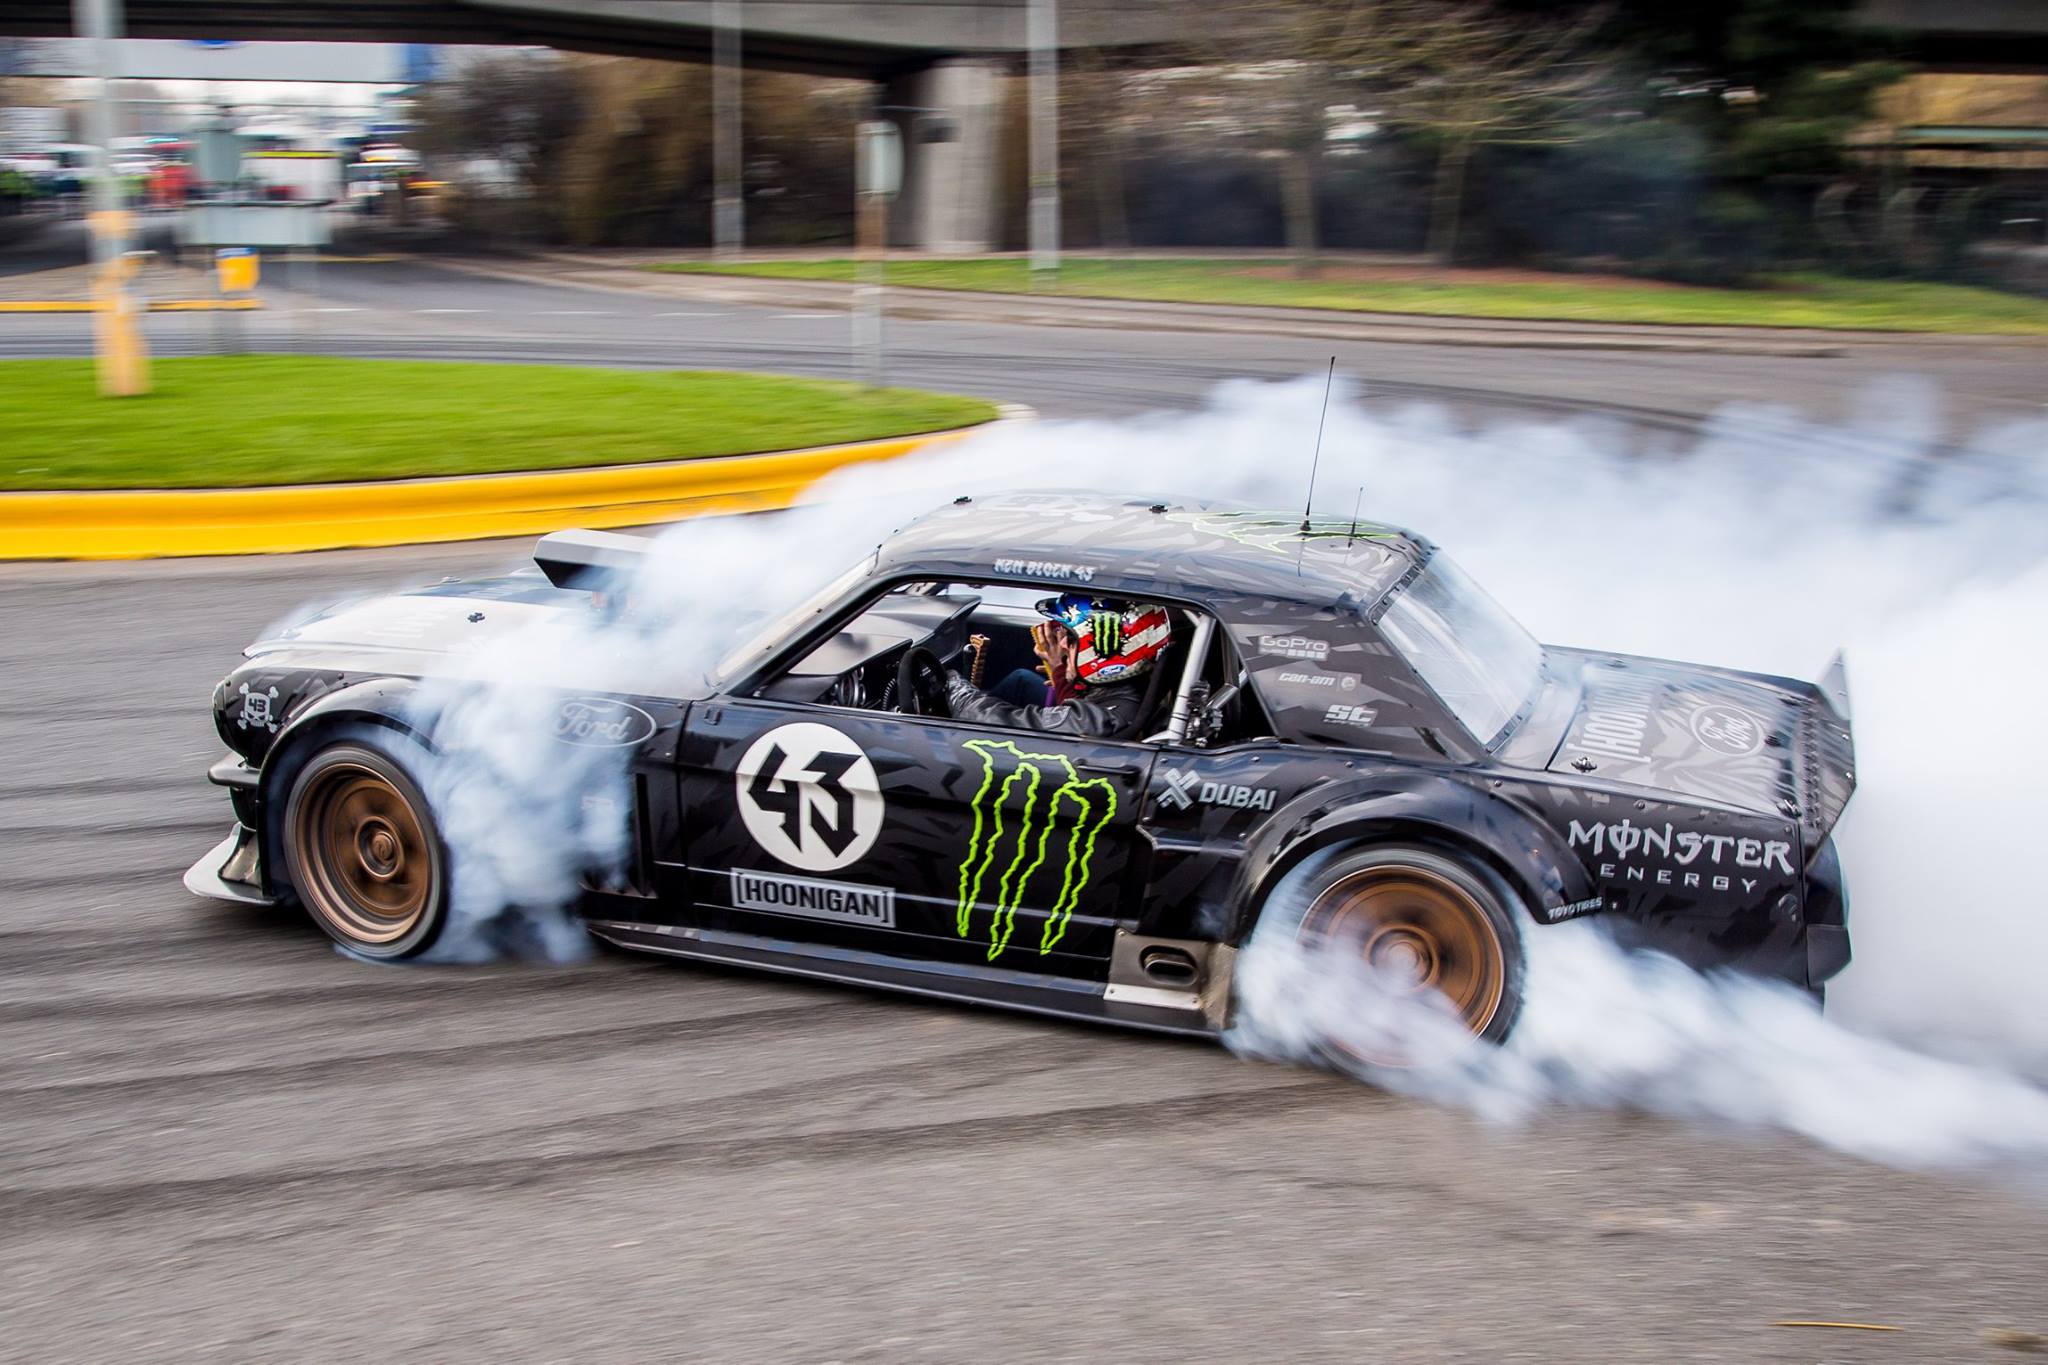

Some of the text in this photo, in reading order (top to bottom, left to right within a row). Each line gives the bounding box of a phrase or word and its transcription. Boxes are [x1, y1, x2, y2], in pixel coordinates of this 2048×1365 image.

[1260, 635, 1328, 652] GoPro
[1279, 672, 1336, 686] can-am
[248, 698, 267, 713] 43
[552, 702, 632, 740] Ford
[747, 742, 863, 859] 43
[1198, 782, 1277, 811] DUBAI
[1600, 863, 1757, 893] ENERGY
